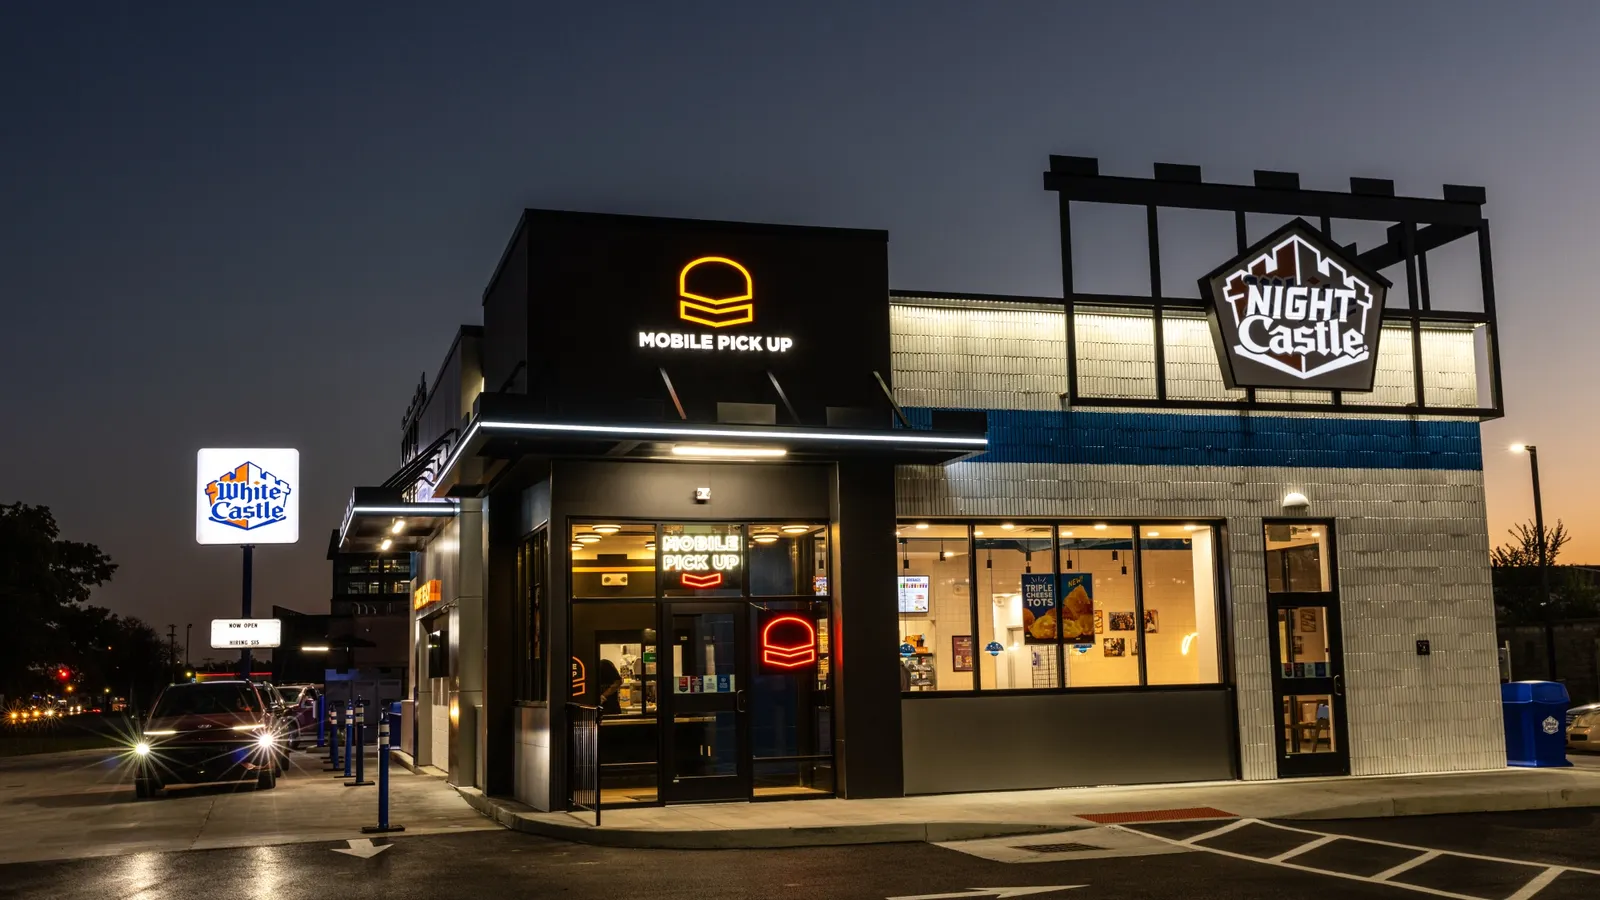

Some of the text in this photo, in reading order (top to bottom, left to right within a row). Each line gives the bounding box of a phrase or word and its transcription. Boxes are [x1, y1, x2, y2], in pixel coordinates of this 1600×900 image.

[1246, 284, 1356, 322] NIGHT
[638, 331, 793, 352] MOBILE PICK UP
[1238, 315, 1364, 358] Castle
[217, 482, 282, 503] White
[211, 501, 284, 520] Castle
[662, 535, 739, 552] MOBILE
[662, 554, 740, 571] PICK UP
[1025, 584, 1053, 592] TRIPLE
[1026, 591, 1053, 599] CHEESE
[1026, 598, 1054, 607] TOTS
